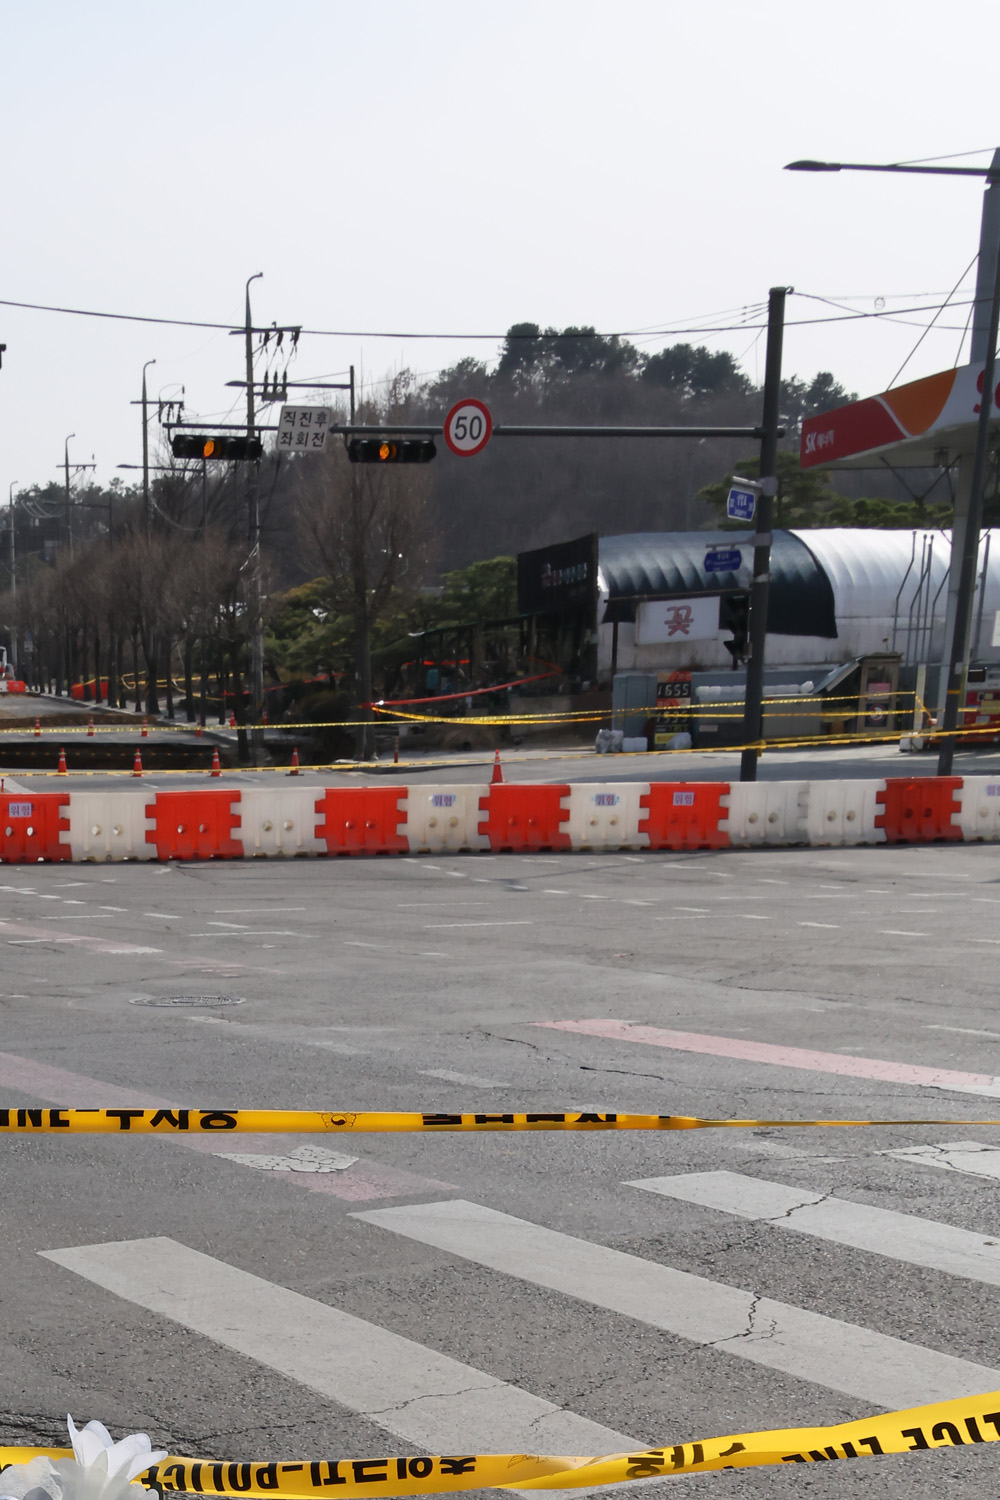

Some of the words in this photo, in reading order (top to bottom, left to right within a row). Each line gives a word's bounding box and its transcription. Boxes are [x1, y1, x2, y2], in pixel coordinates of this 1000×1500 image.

[283, 410, 328, 428] 직진후
[454, 415, 483, 441] 50
[279, 431, 326, 448] 좌회전
[804, 430, 818, 455] SK
[663, 604, 695, 637] 꽃
[657, 683, 690, 697] 1655
[9, 803, 32, 817] 위험
